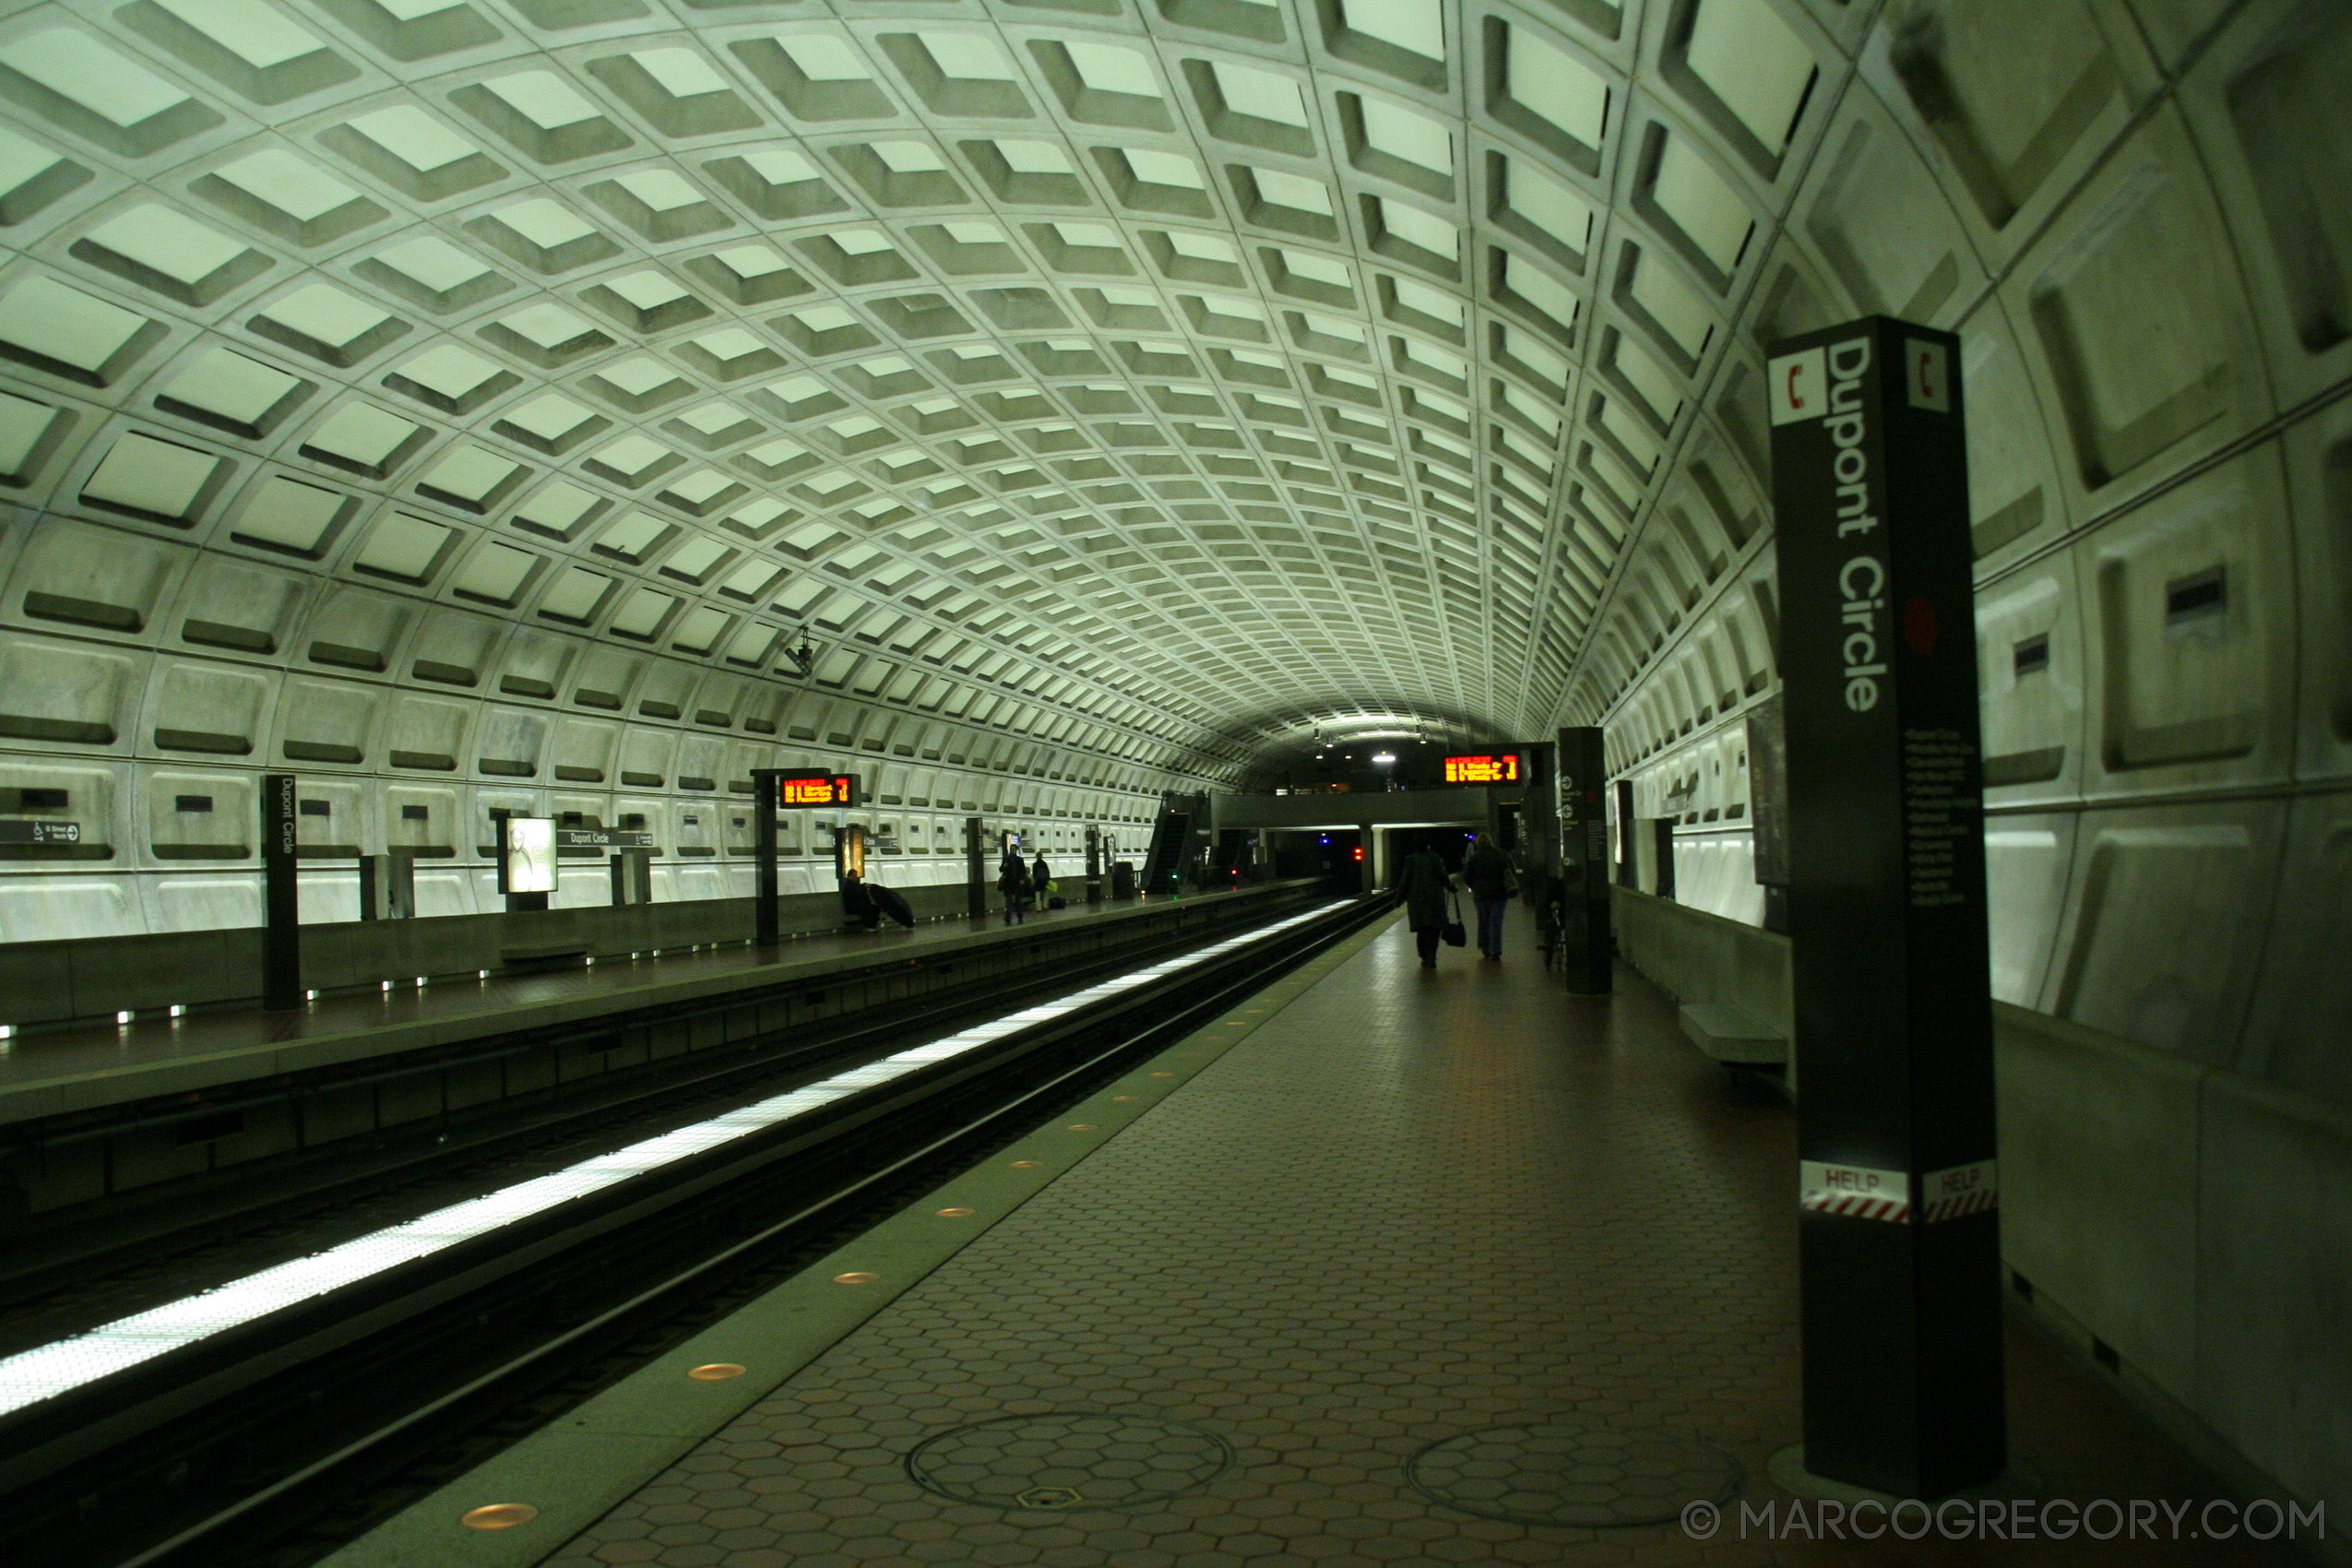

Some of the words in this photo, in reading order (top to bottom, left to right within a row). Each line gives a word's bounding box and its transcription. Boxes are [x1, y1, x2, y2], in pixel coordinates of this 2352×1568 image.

[1823, 336, 1878, 539] Dupont
[1838, 555, 1887, 713] Circle
[280, 778, 294, 819] Dupont
[282, 822, 294, 854] Circle
[570, 833, 591, 845] Dupont
[592, 833, 609, 843] Circle
[1825, 1169, 1880, 1193] HELP
[1942, 1168, 1980, 1194] HELP
